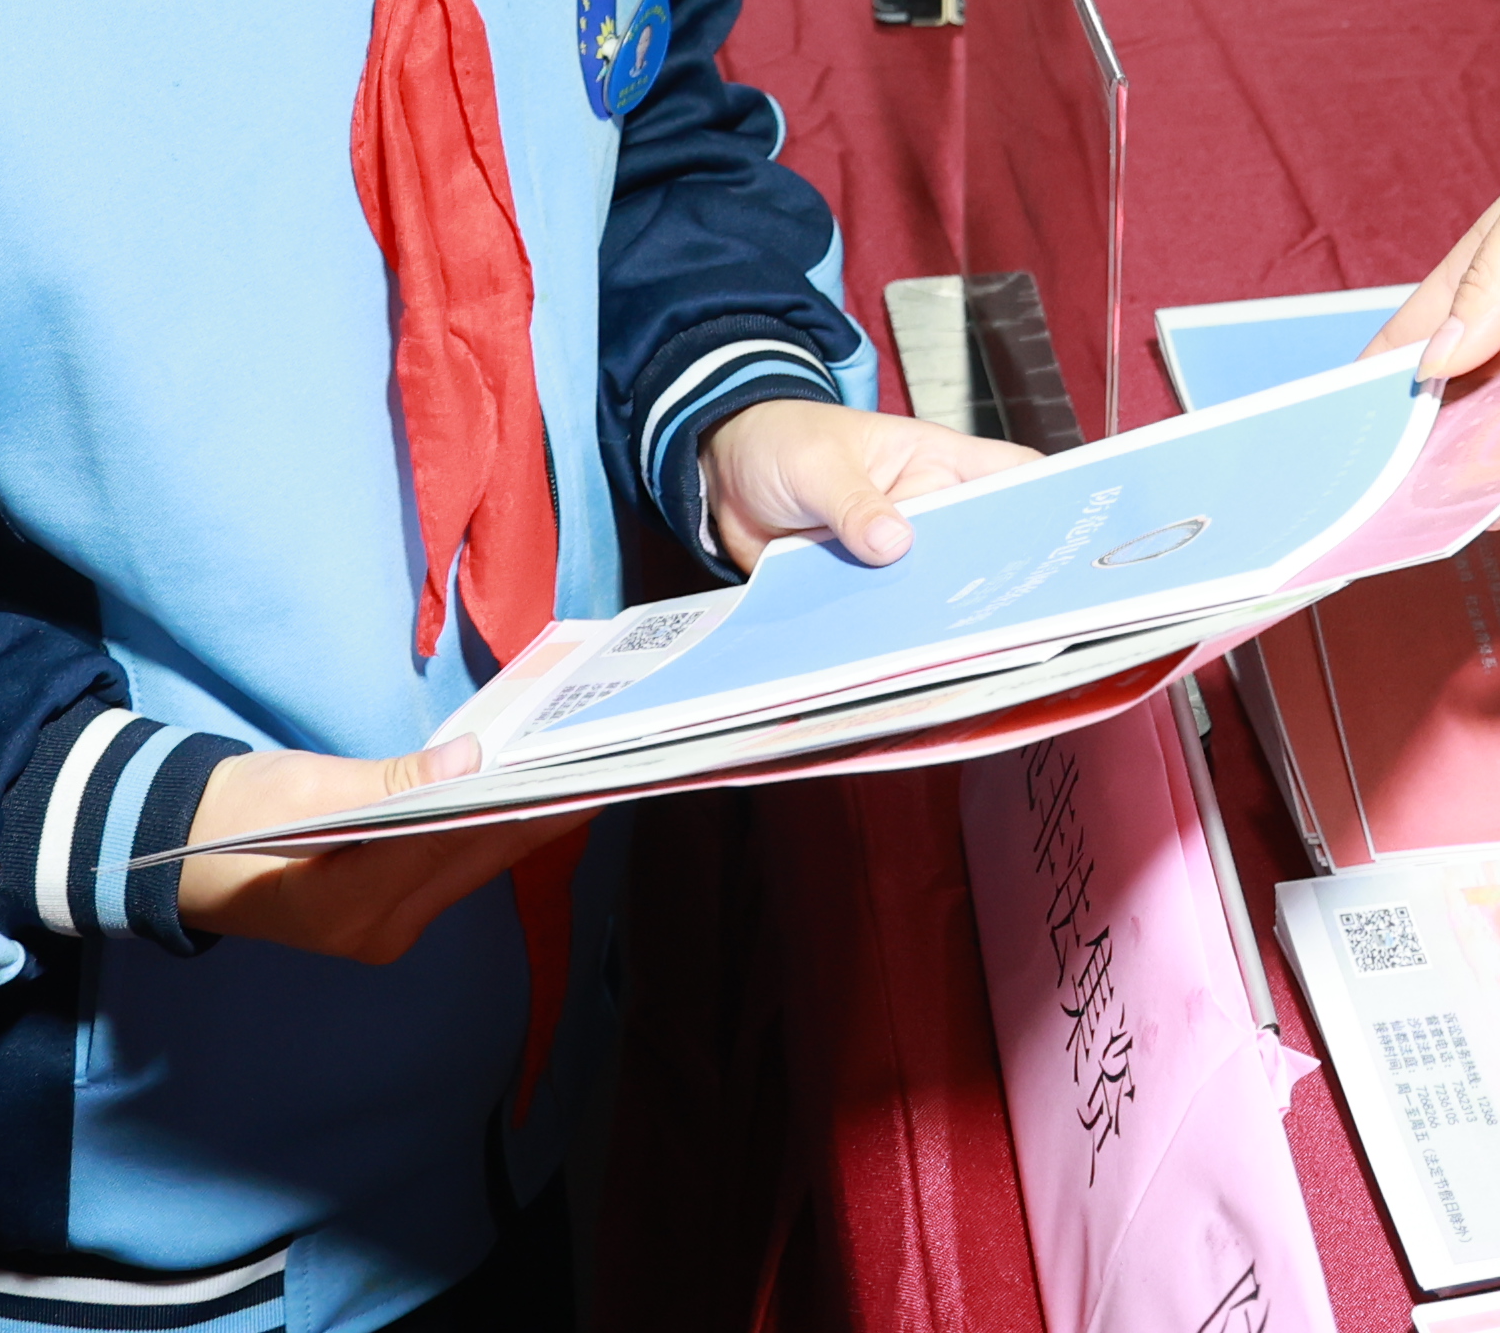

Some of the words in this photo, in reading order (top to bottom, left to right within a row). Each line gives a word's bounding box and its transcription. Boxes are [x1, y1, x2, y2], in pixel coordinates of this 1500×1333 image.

[1390, 1020, 1418, 1073] 仙都法庭：
[1415, 1085, 1440, 1129] 7268266
[1407, 1017, 1436, 1072] 沙建法庭：
[1434, 1083, 1459, 1126] 7236105
[1425, 1014, 1454, 1069] 督查电话：
[1452, 1080, 1477, 1123] 7362313
[1442, 1011, 1483, 1090] 诉讼服务热线：
[1476, 1095, 1498, 1127] 12368
[1372, 1021, 1402, 1076] 接待时间：
[1395, 1081, 1472, 1244] 周一至周五（法定节假日除外）
